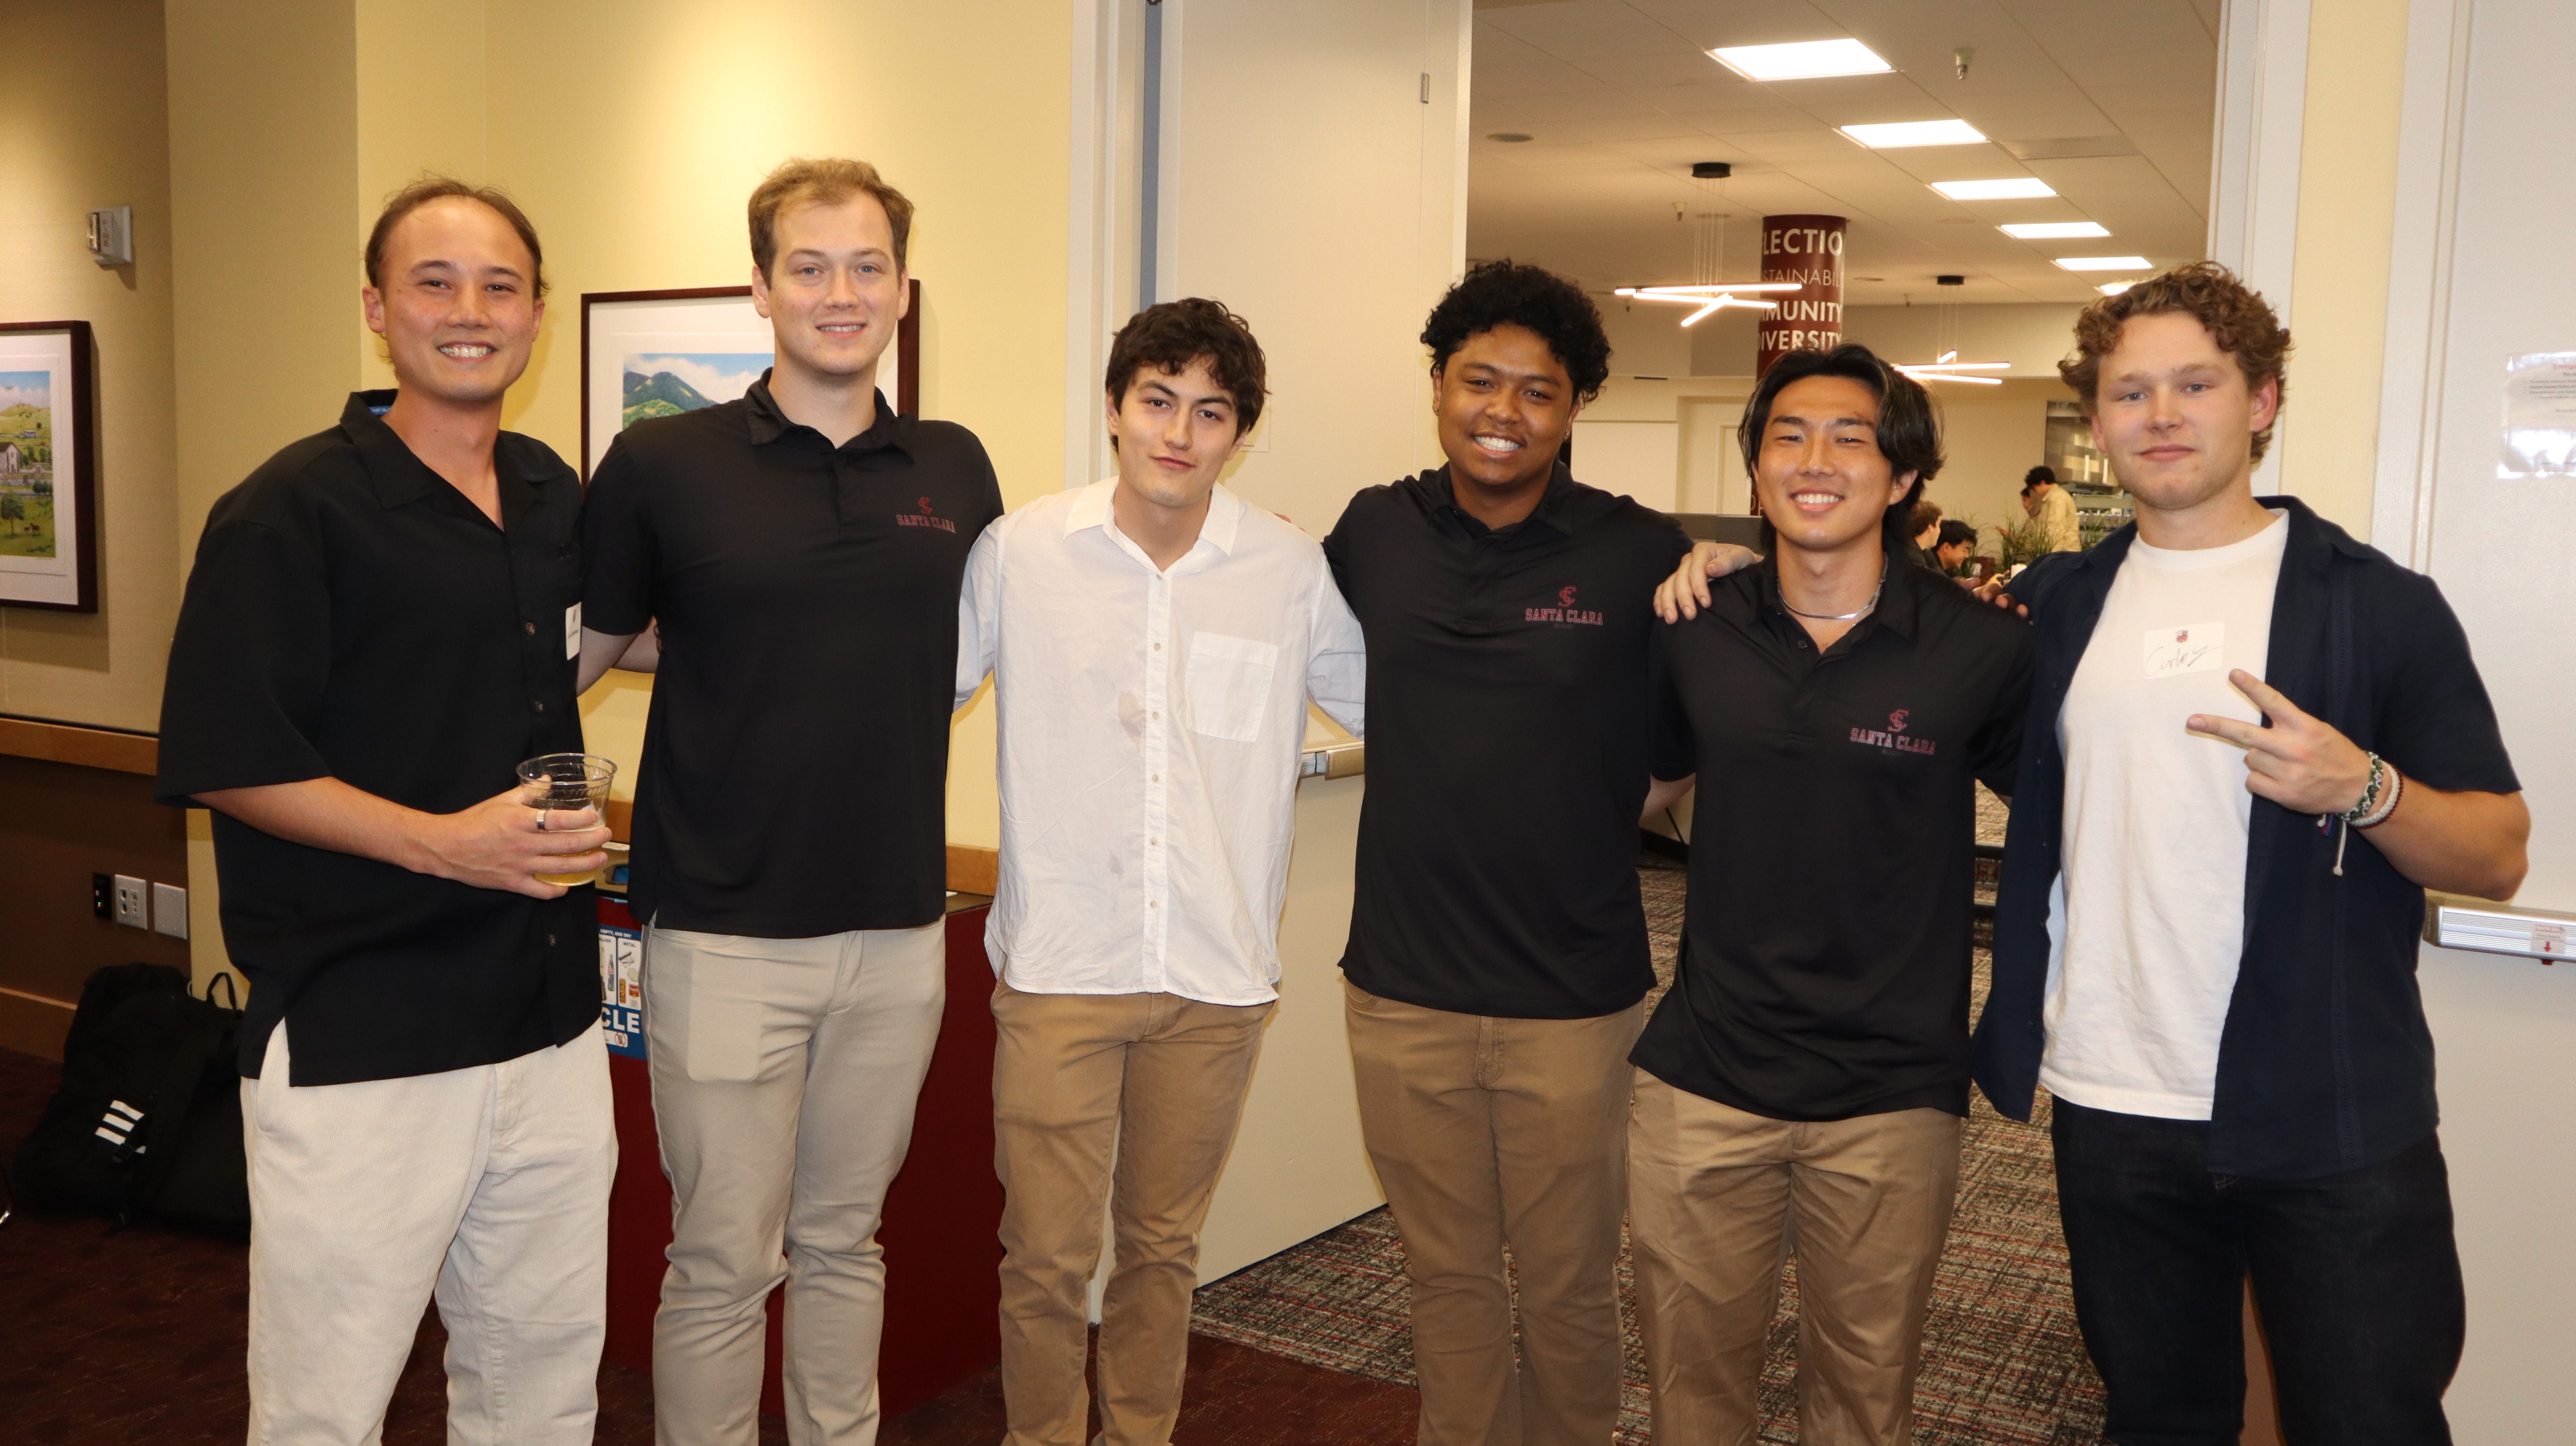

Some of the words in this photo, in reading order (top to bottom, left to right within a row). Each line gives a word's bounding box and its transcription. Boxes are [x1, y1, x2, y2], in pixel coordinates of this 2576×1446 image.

[896, 514, 931, 527] SANTA
[1525, 608, 1563, 622] SANTA
[1566, 610, 1603, 625] CLARA
[1850, 728, 1893, 748] SANTA
[1896, 735, 1935, 755] CLARA
